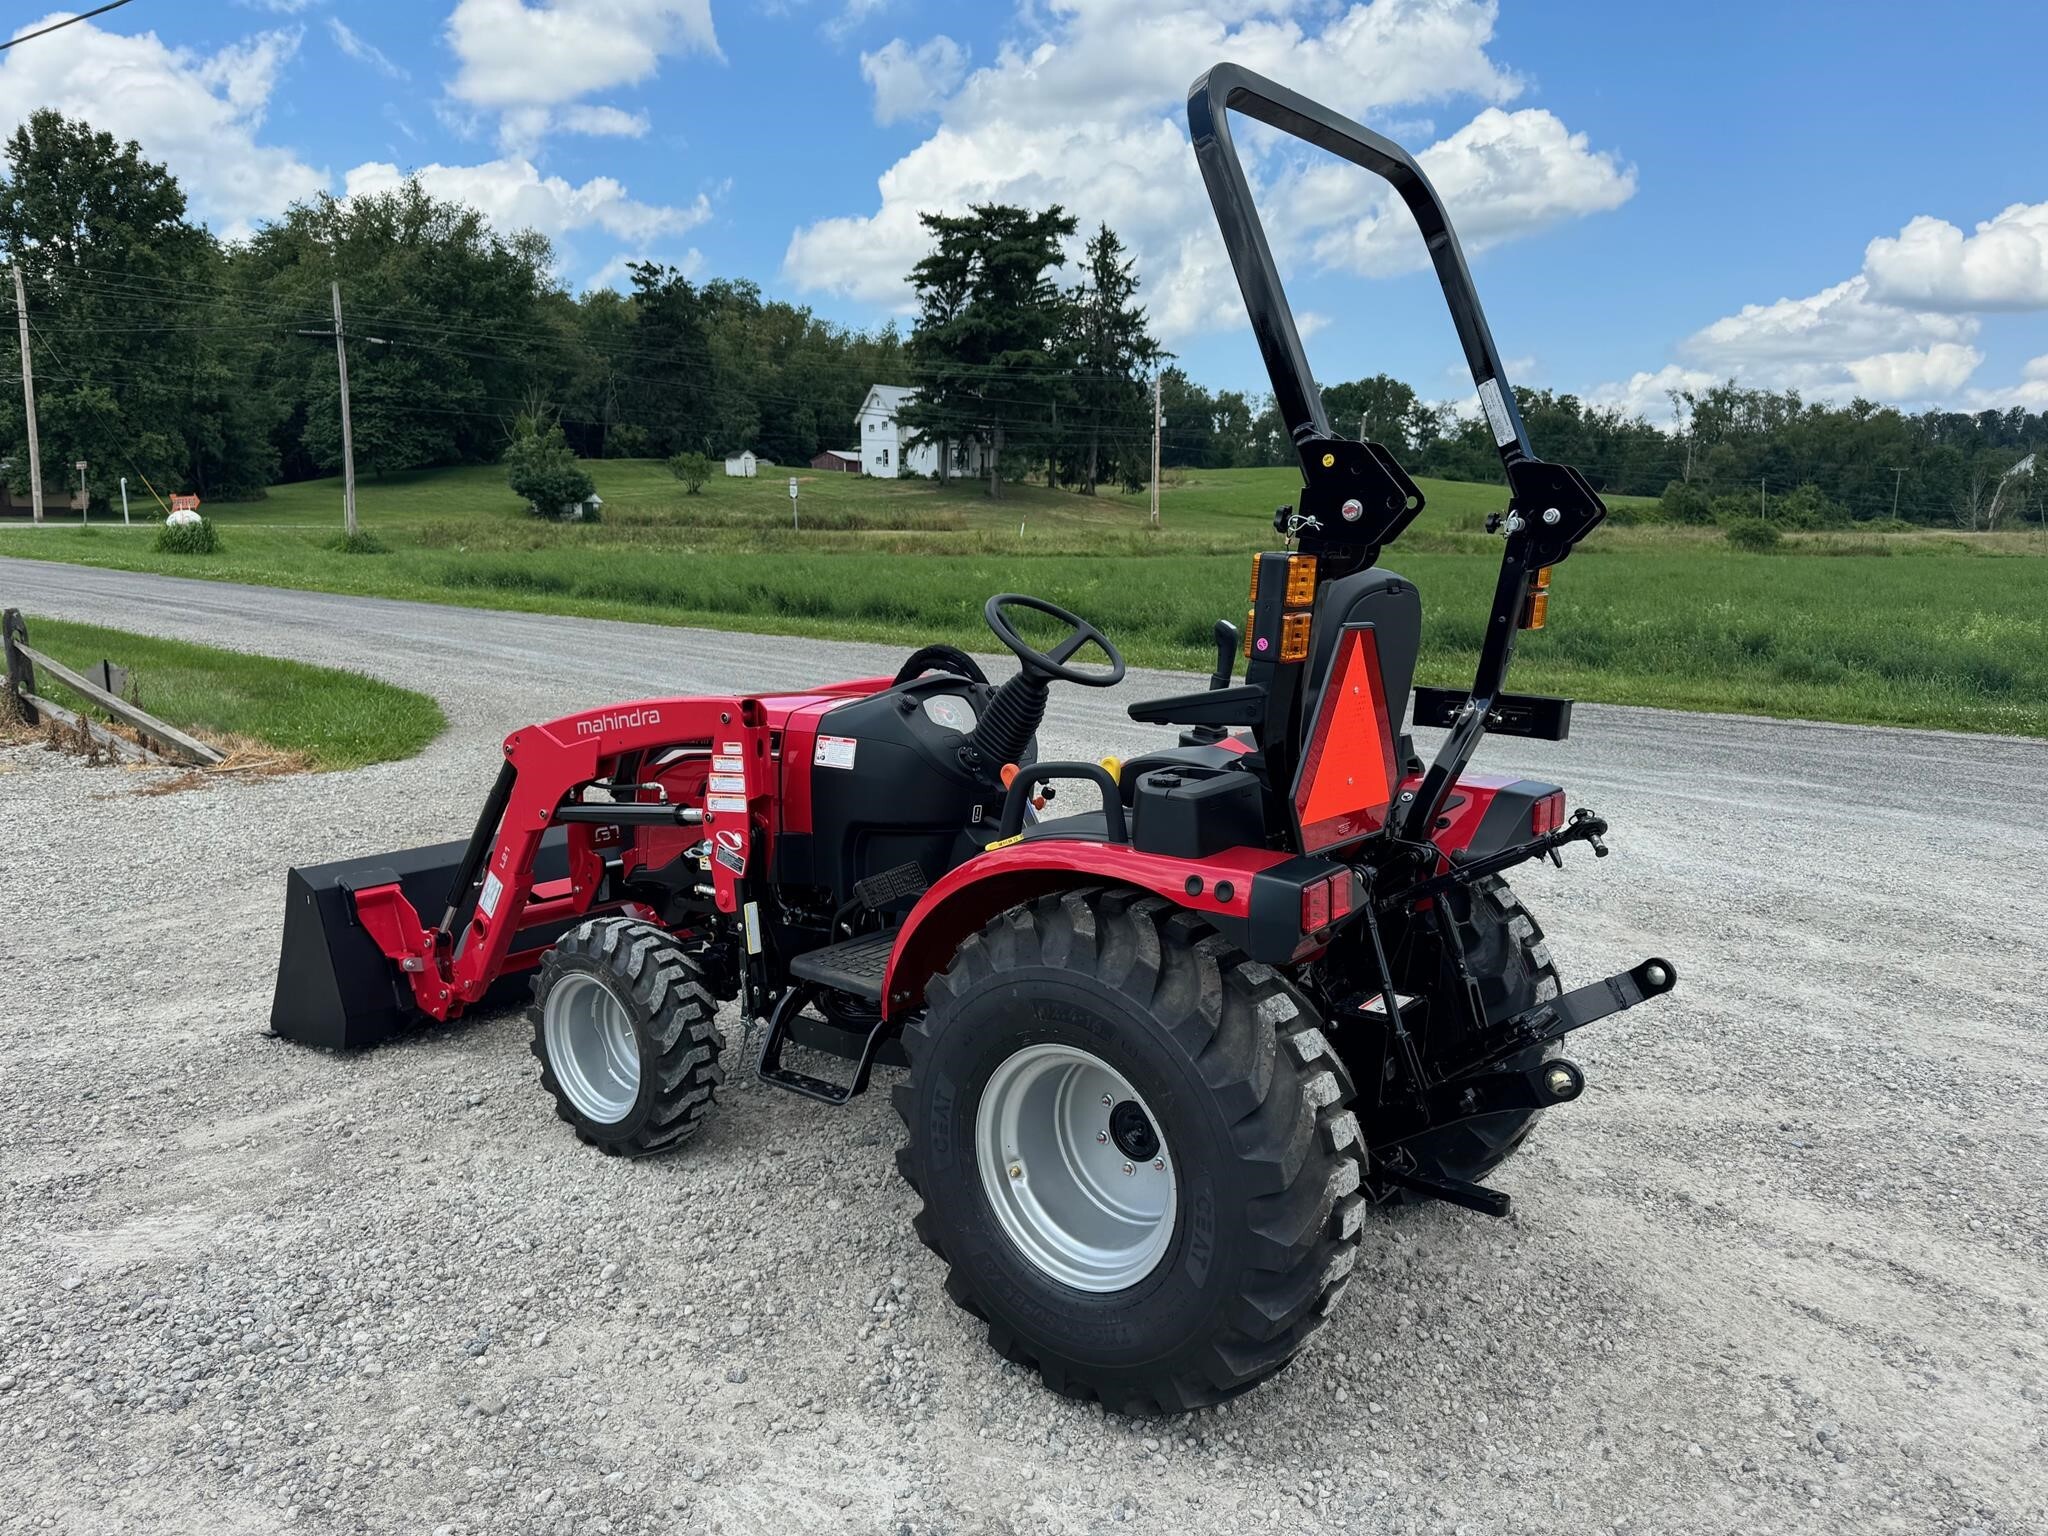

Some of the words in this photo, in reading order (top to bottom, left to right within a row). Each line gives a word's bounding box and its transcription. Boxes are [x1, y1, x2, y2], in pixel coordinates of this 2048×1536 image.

[576, 708, 661, 735] mahindra
[932, 1089, 951, 1152] CEAT
[1191, 1193, 1211, 1270] CEAT
